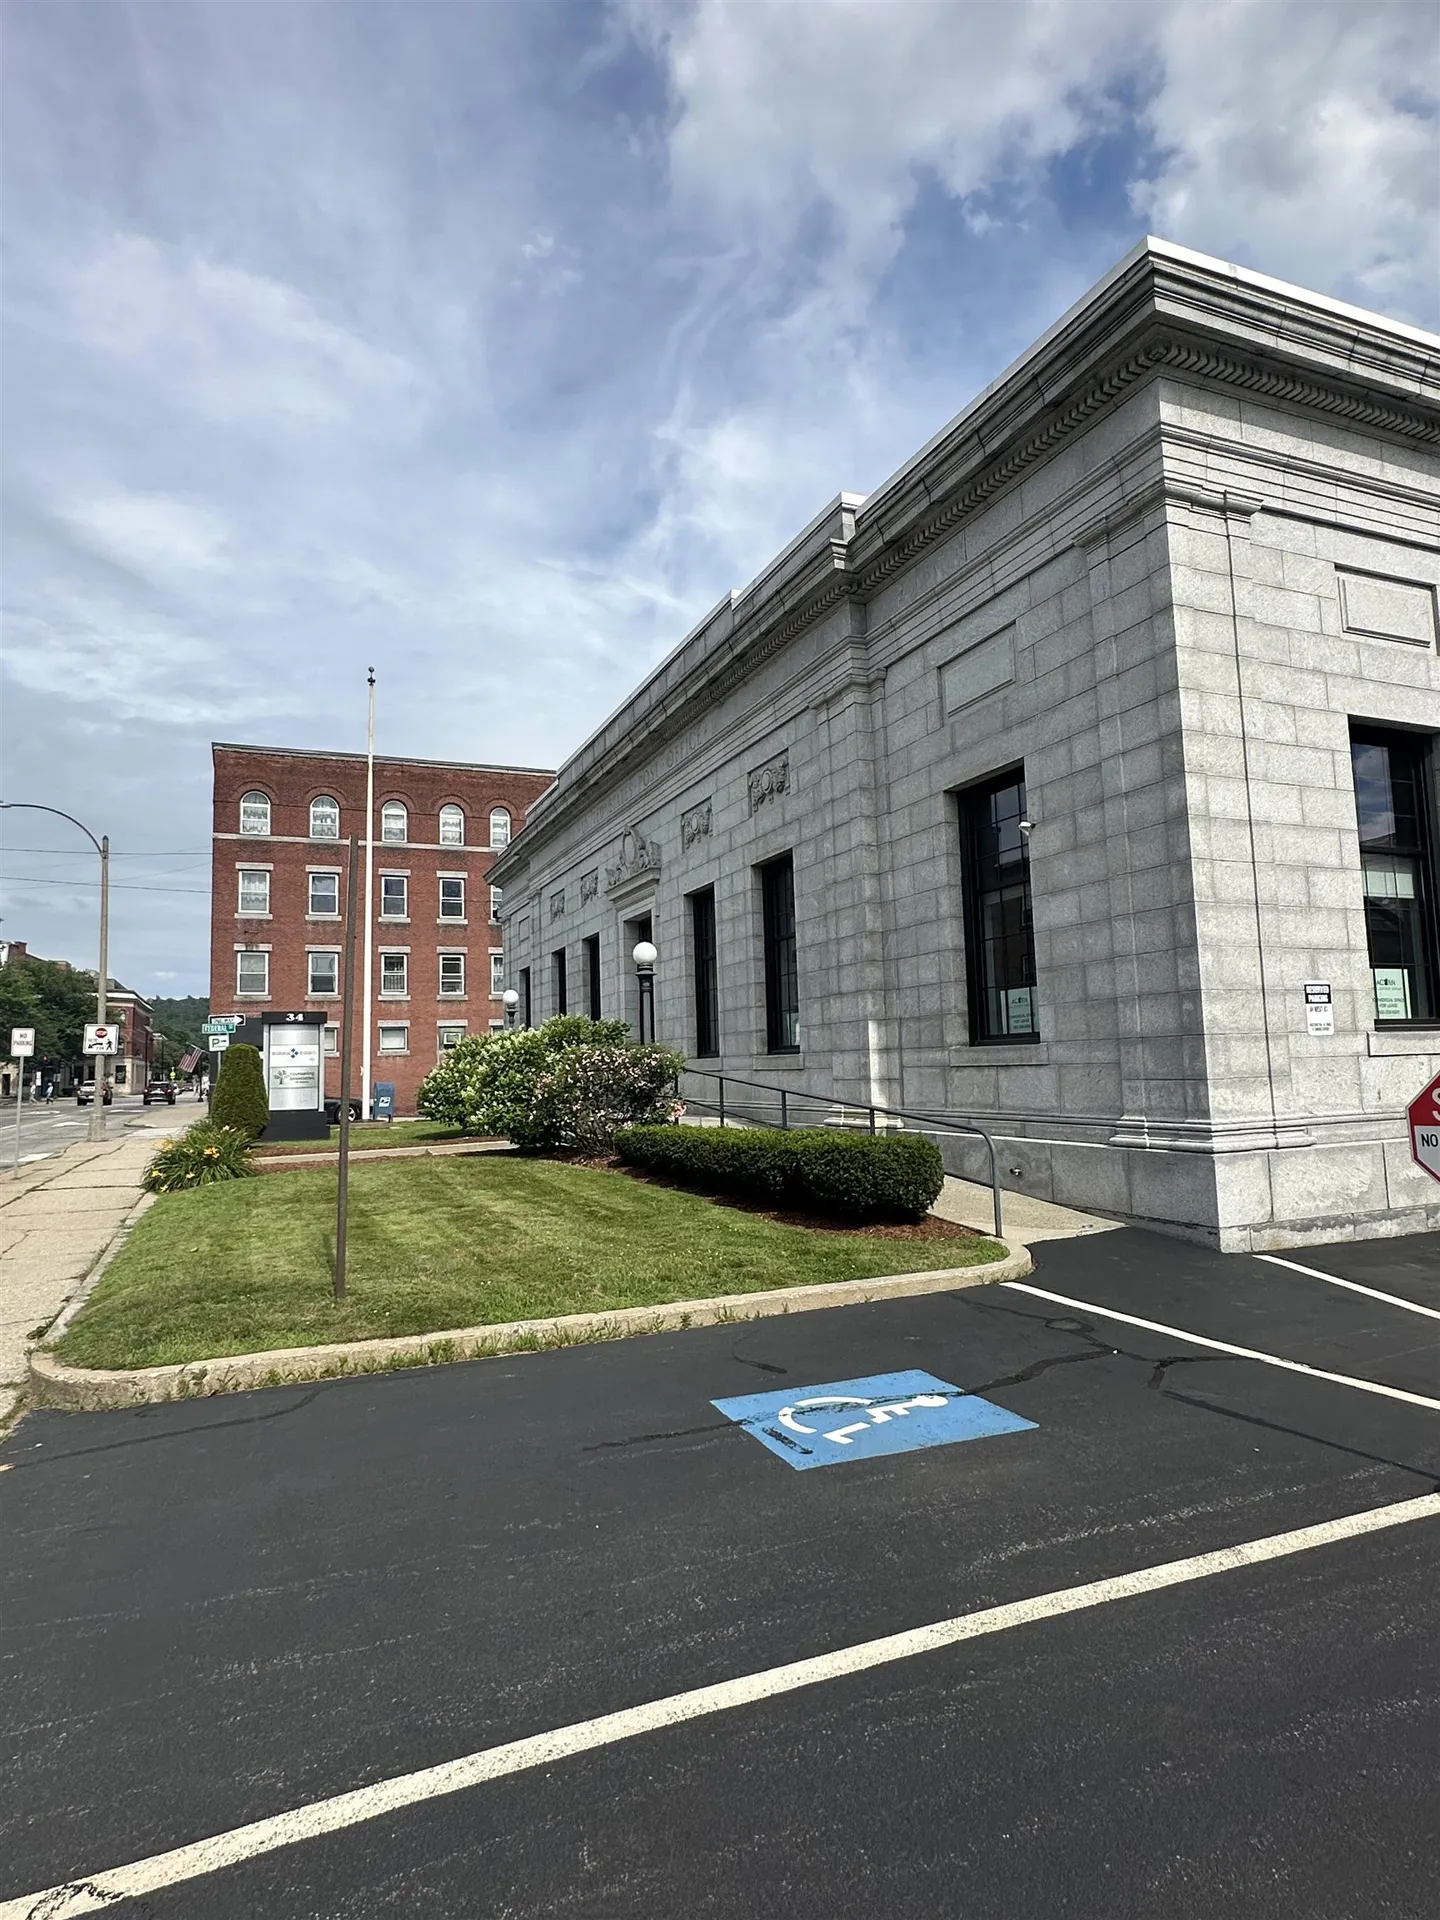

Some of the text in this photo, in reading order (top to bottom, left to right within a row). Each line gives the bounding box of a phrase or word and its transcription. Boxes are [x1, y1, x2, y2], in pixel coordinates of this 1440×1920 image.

[666, 728, 702, 768] OFFICE
[1307, 994, 1329, 1003] PARKING
[285, 1013, 304, 1022] 34
[204, 1024, 227, 1033] FEDERAL
[212, 1038, 220, 1048] P
[1421, 1133, 1439, 1147] NO
